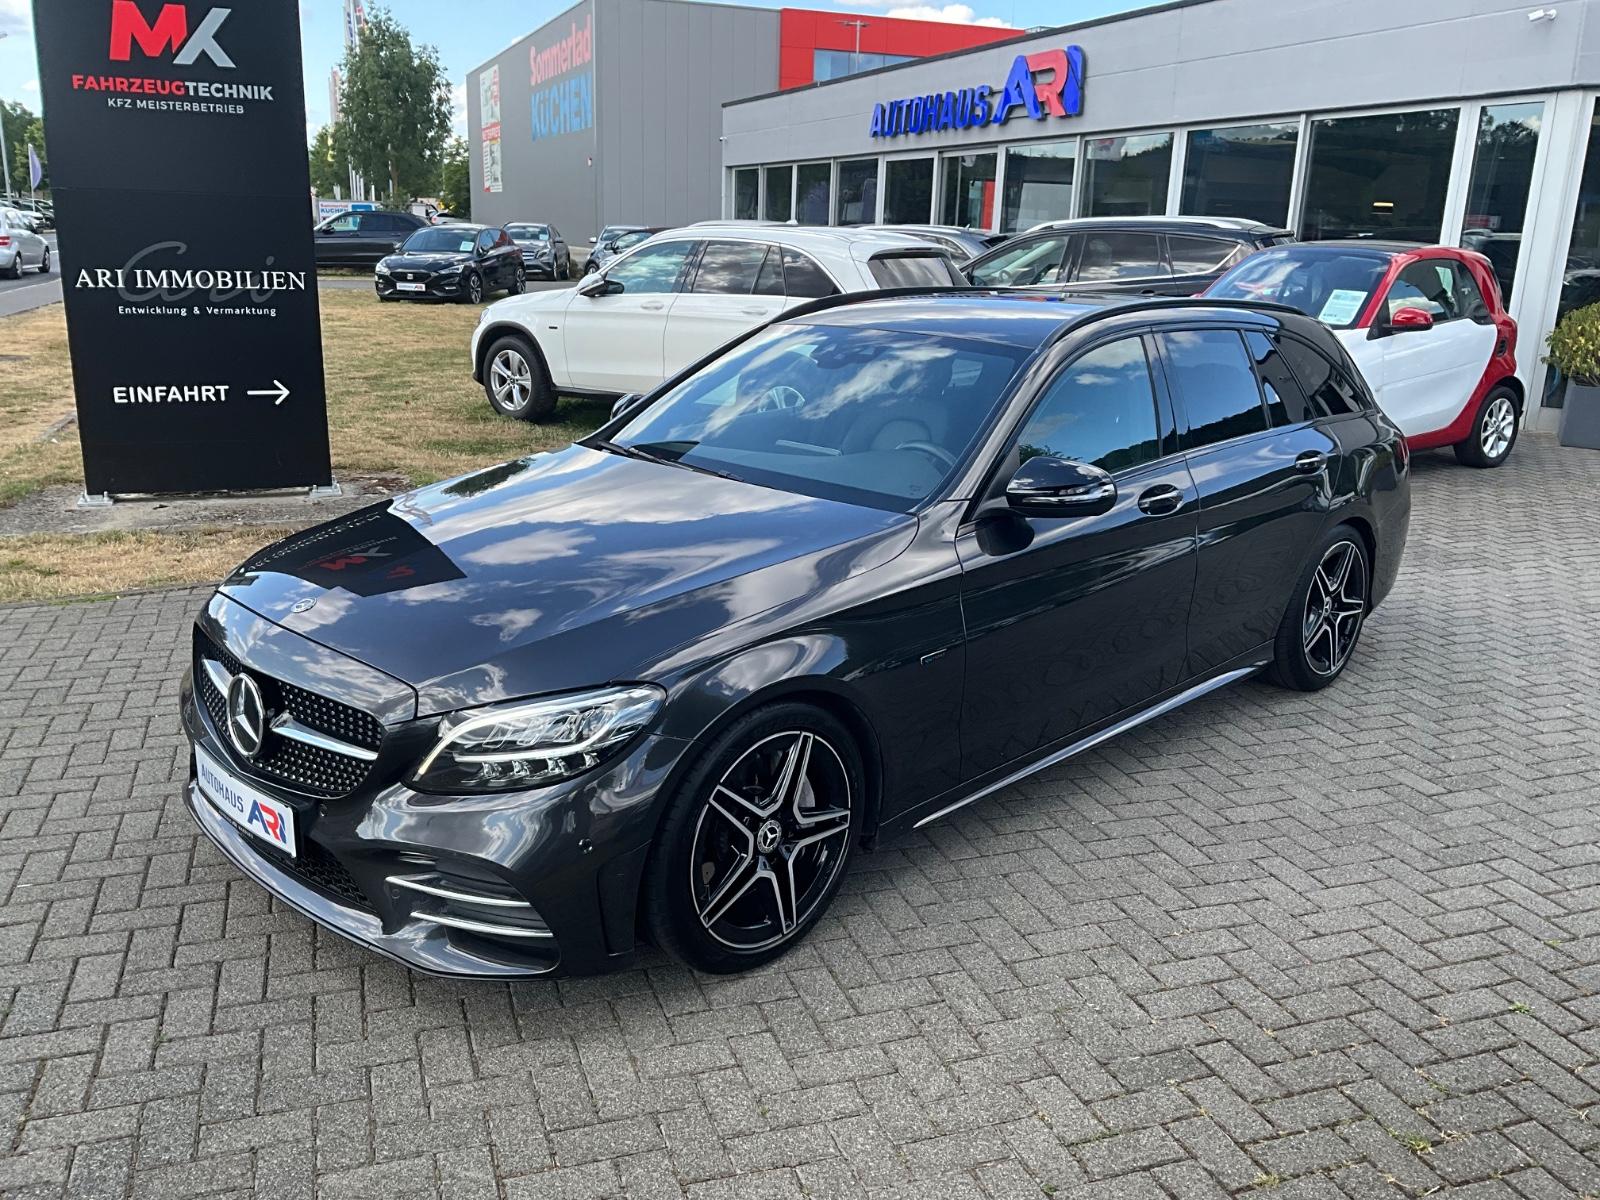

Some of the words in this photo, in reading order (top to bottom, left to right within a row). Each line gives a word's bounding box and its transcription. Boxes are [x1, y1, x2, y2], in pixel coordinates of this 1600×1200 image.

[110, 0, 237, 68] MK
[530, 14, 592, 86] Sommerlad
[71, 74, 274, 101] FAHRZEUGTECHNIK
[107, 97, 133, 109] KFZ
[136, 99, 245, 115] MEISTERBETRIEB
[530, 71, 593, 143] KÜCHEN
[869, 84, 991, 138] AUTOHAUS
[991, 44, 1085, 124] ARI
[75, 268, 125, 288] ARI
[134, 268, 306, 291] IMMOBILIEN
[118, 305, 188, 317] Entwicklung
[193, 306, 201, 316] &
[206, 306, 277, 317] Vermarktung
[112, 385, 230, 404] EINFAHRT
[201, 763, 244, 813] AUTOHAUS
[247, 799, 287, 845] ARI
